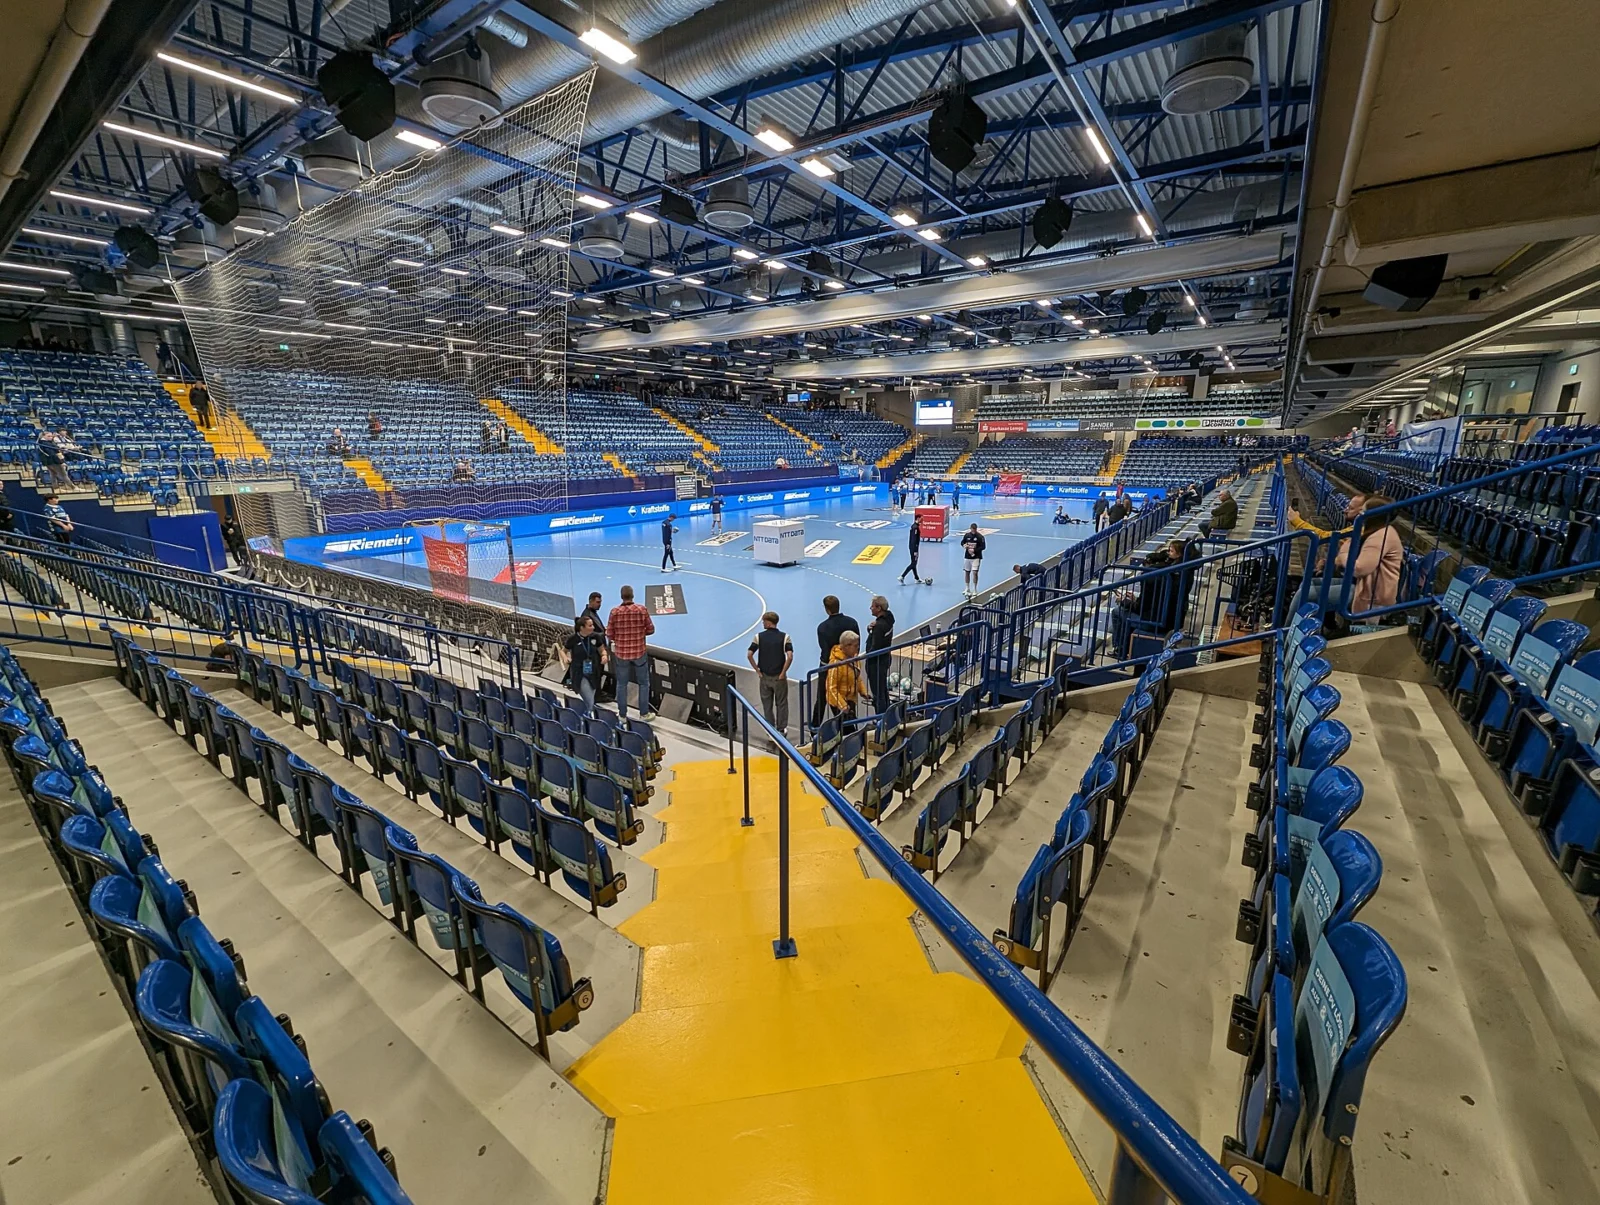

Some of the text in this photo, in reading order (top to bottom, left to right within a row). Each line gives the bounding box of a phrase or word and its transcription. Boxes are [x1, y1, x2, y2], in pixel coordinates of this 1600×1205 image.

[641, 504, 670, 515] Kraftstoffe
[565, 513, 605, 526] Riemeier
[753, 535, 764, 543] NTT
[780, 531, 790, 539] NTT
[348, 533, 414, 551] Riemeier
[1560, 684, 1577, 697] DEINE
[1555, 697, 1566, 706] AUS
[998, 944, 1005, 953] 6
[1314, 967, 1331, 997] DEINE
[1328, 993, 1336, 1009] PV
[582, 994, 589, 1004] 6
[1310, 987, 1334, 1040] AUS & FÜR
[1237, 1171, 1248, 1187] 7
